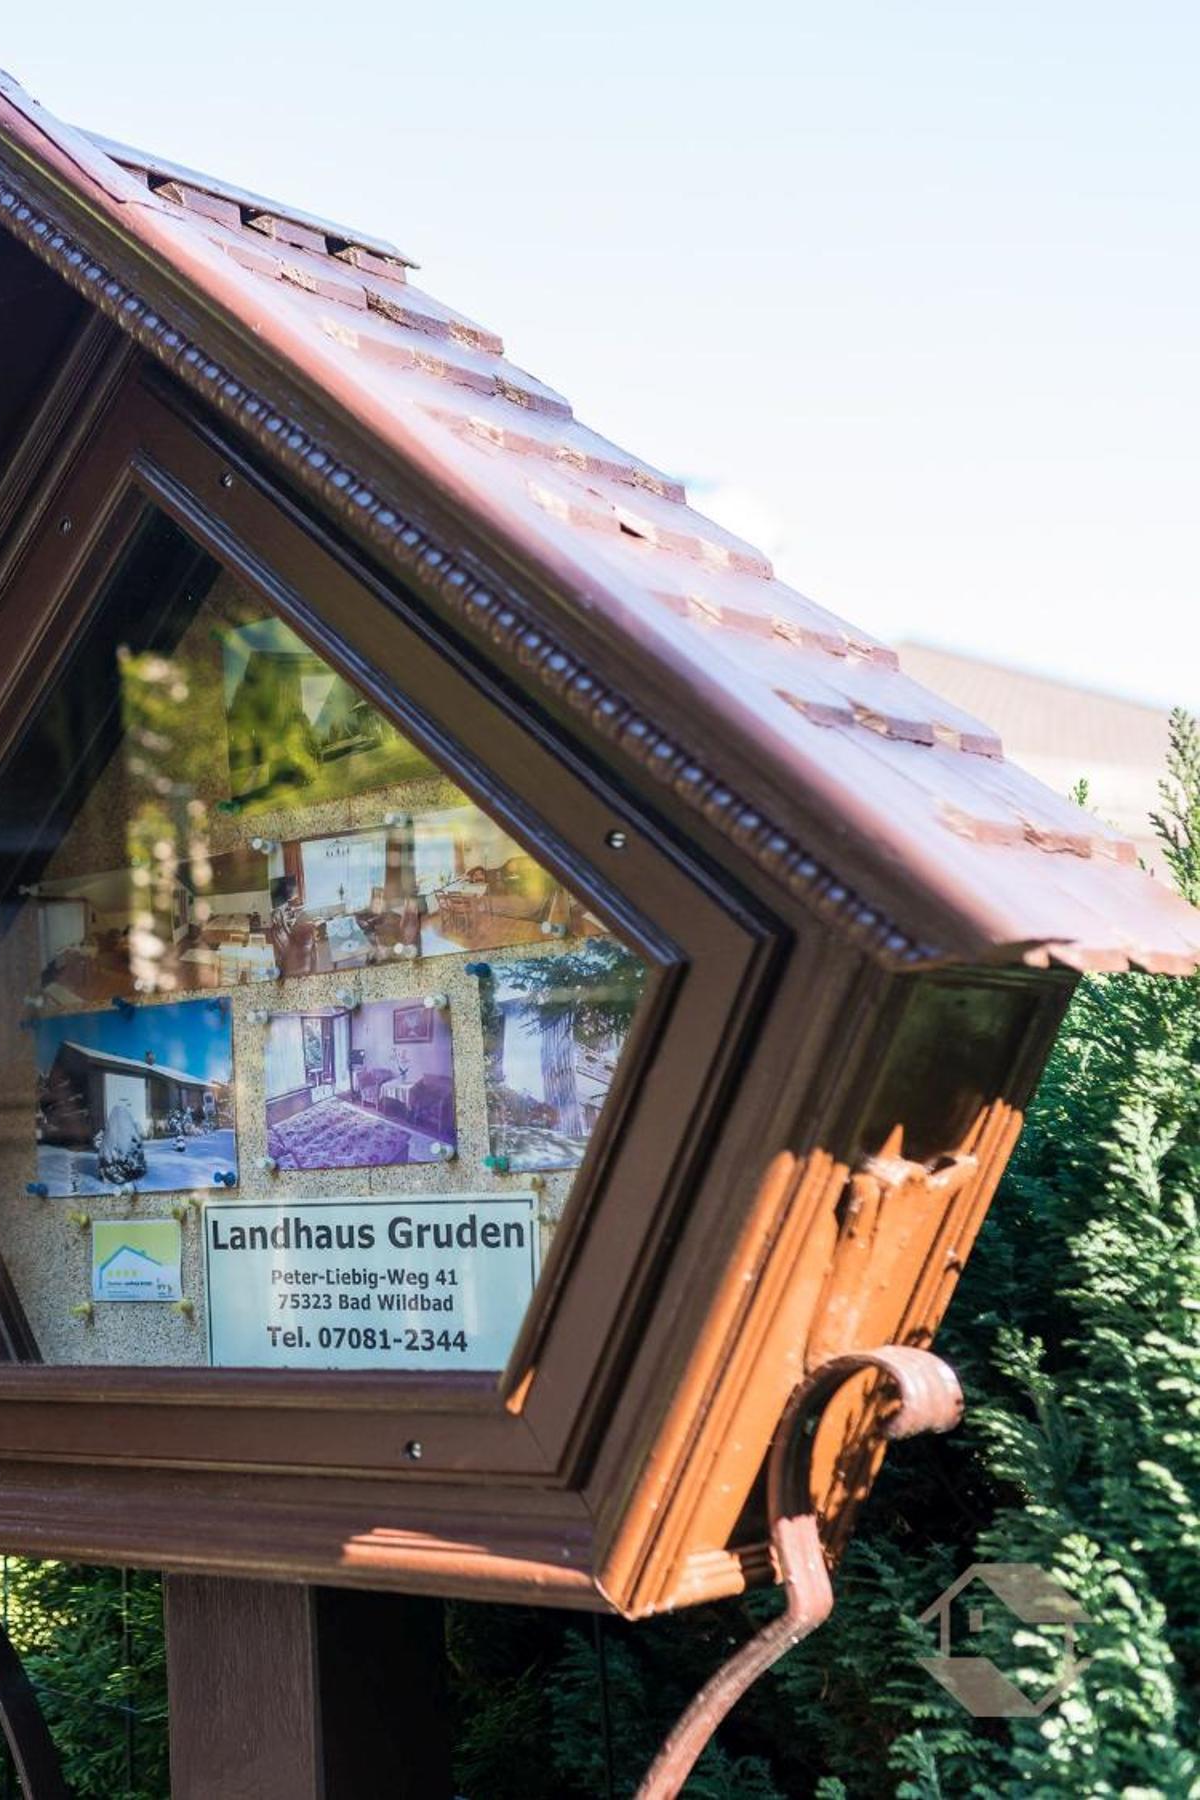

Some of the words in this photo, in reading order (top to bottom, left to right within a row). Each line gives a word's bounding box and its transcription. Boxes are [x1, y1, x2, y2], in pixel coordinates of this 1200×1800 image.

[212, 1217, 376, 1250] Landhaus
[388, 1214, 525, 1248] Gruden
[271, 1269, 430, 1288] Peter-Liebig-Weg
[435, 1269, 458, 1285] 41
[278, 1294, 333, 1310] 75323
[339, 1294, 372, 1311] Bad
[379, 1294, 454, 1311] Wildbad
[267, 1326, 311, 1348] Tel.
[318, 1327, 468, 1352] 07081-2344
